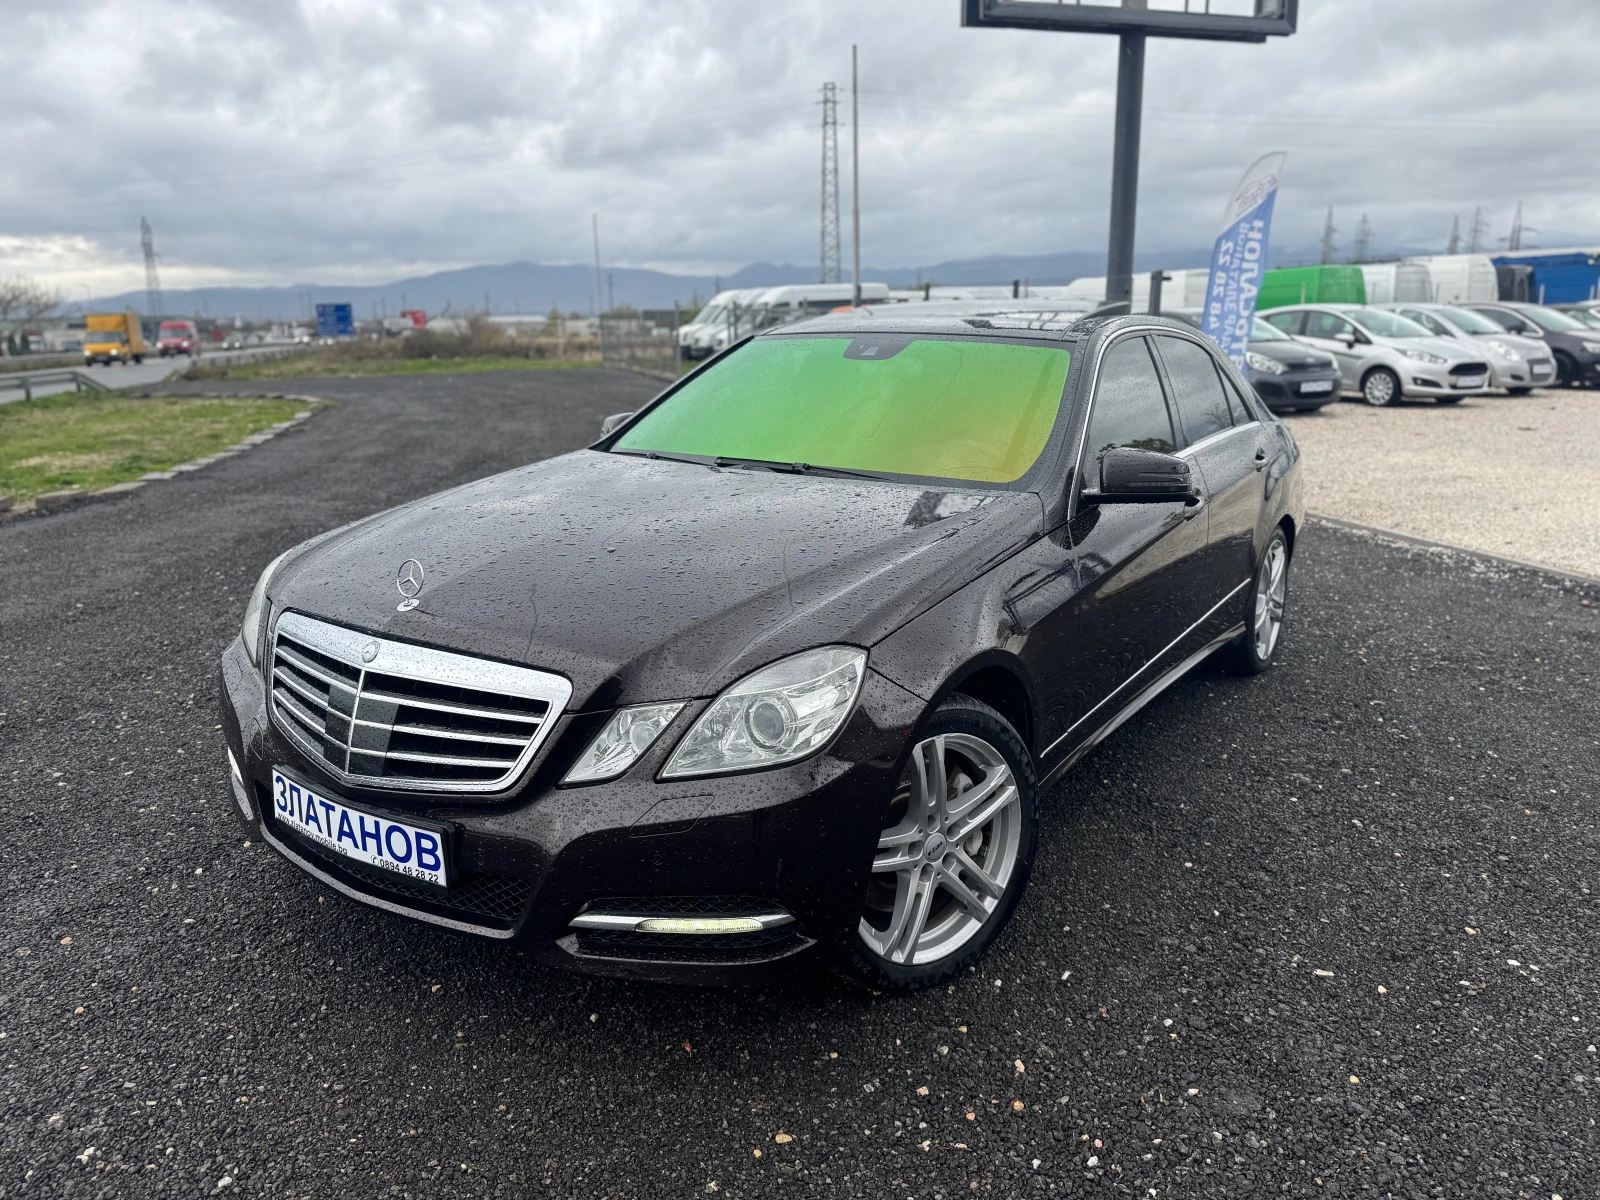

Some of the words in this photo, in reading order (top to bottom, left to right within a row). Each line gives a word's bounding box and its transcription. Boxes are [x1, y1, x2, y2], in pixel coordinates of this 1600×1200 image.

[275, 775, 442, 872] ЗЛАТАНОВ
[379, 858, 400, 873] 0894
[402, 865, 413, 877] 48
[415, 869, 426, 880] 28
[428, 872, 439, 884] 22
